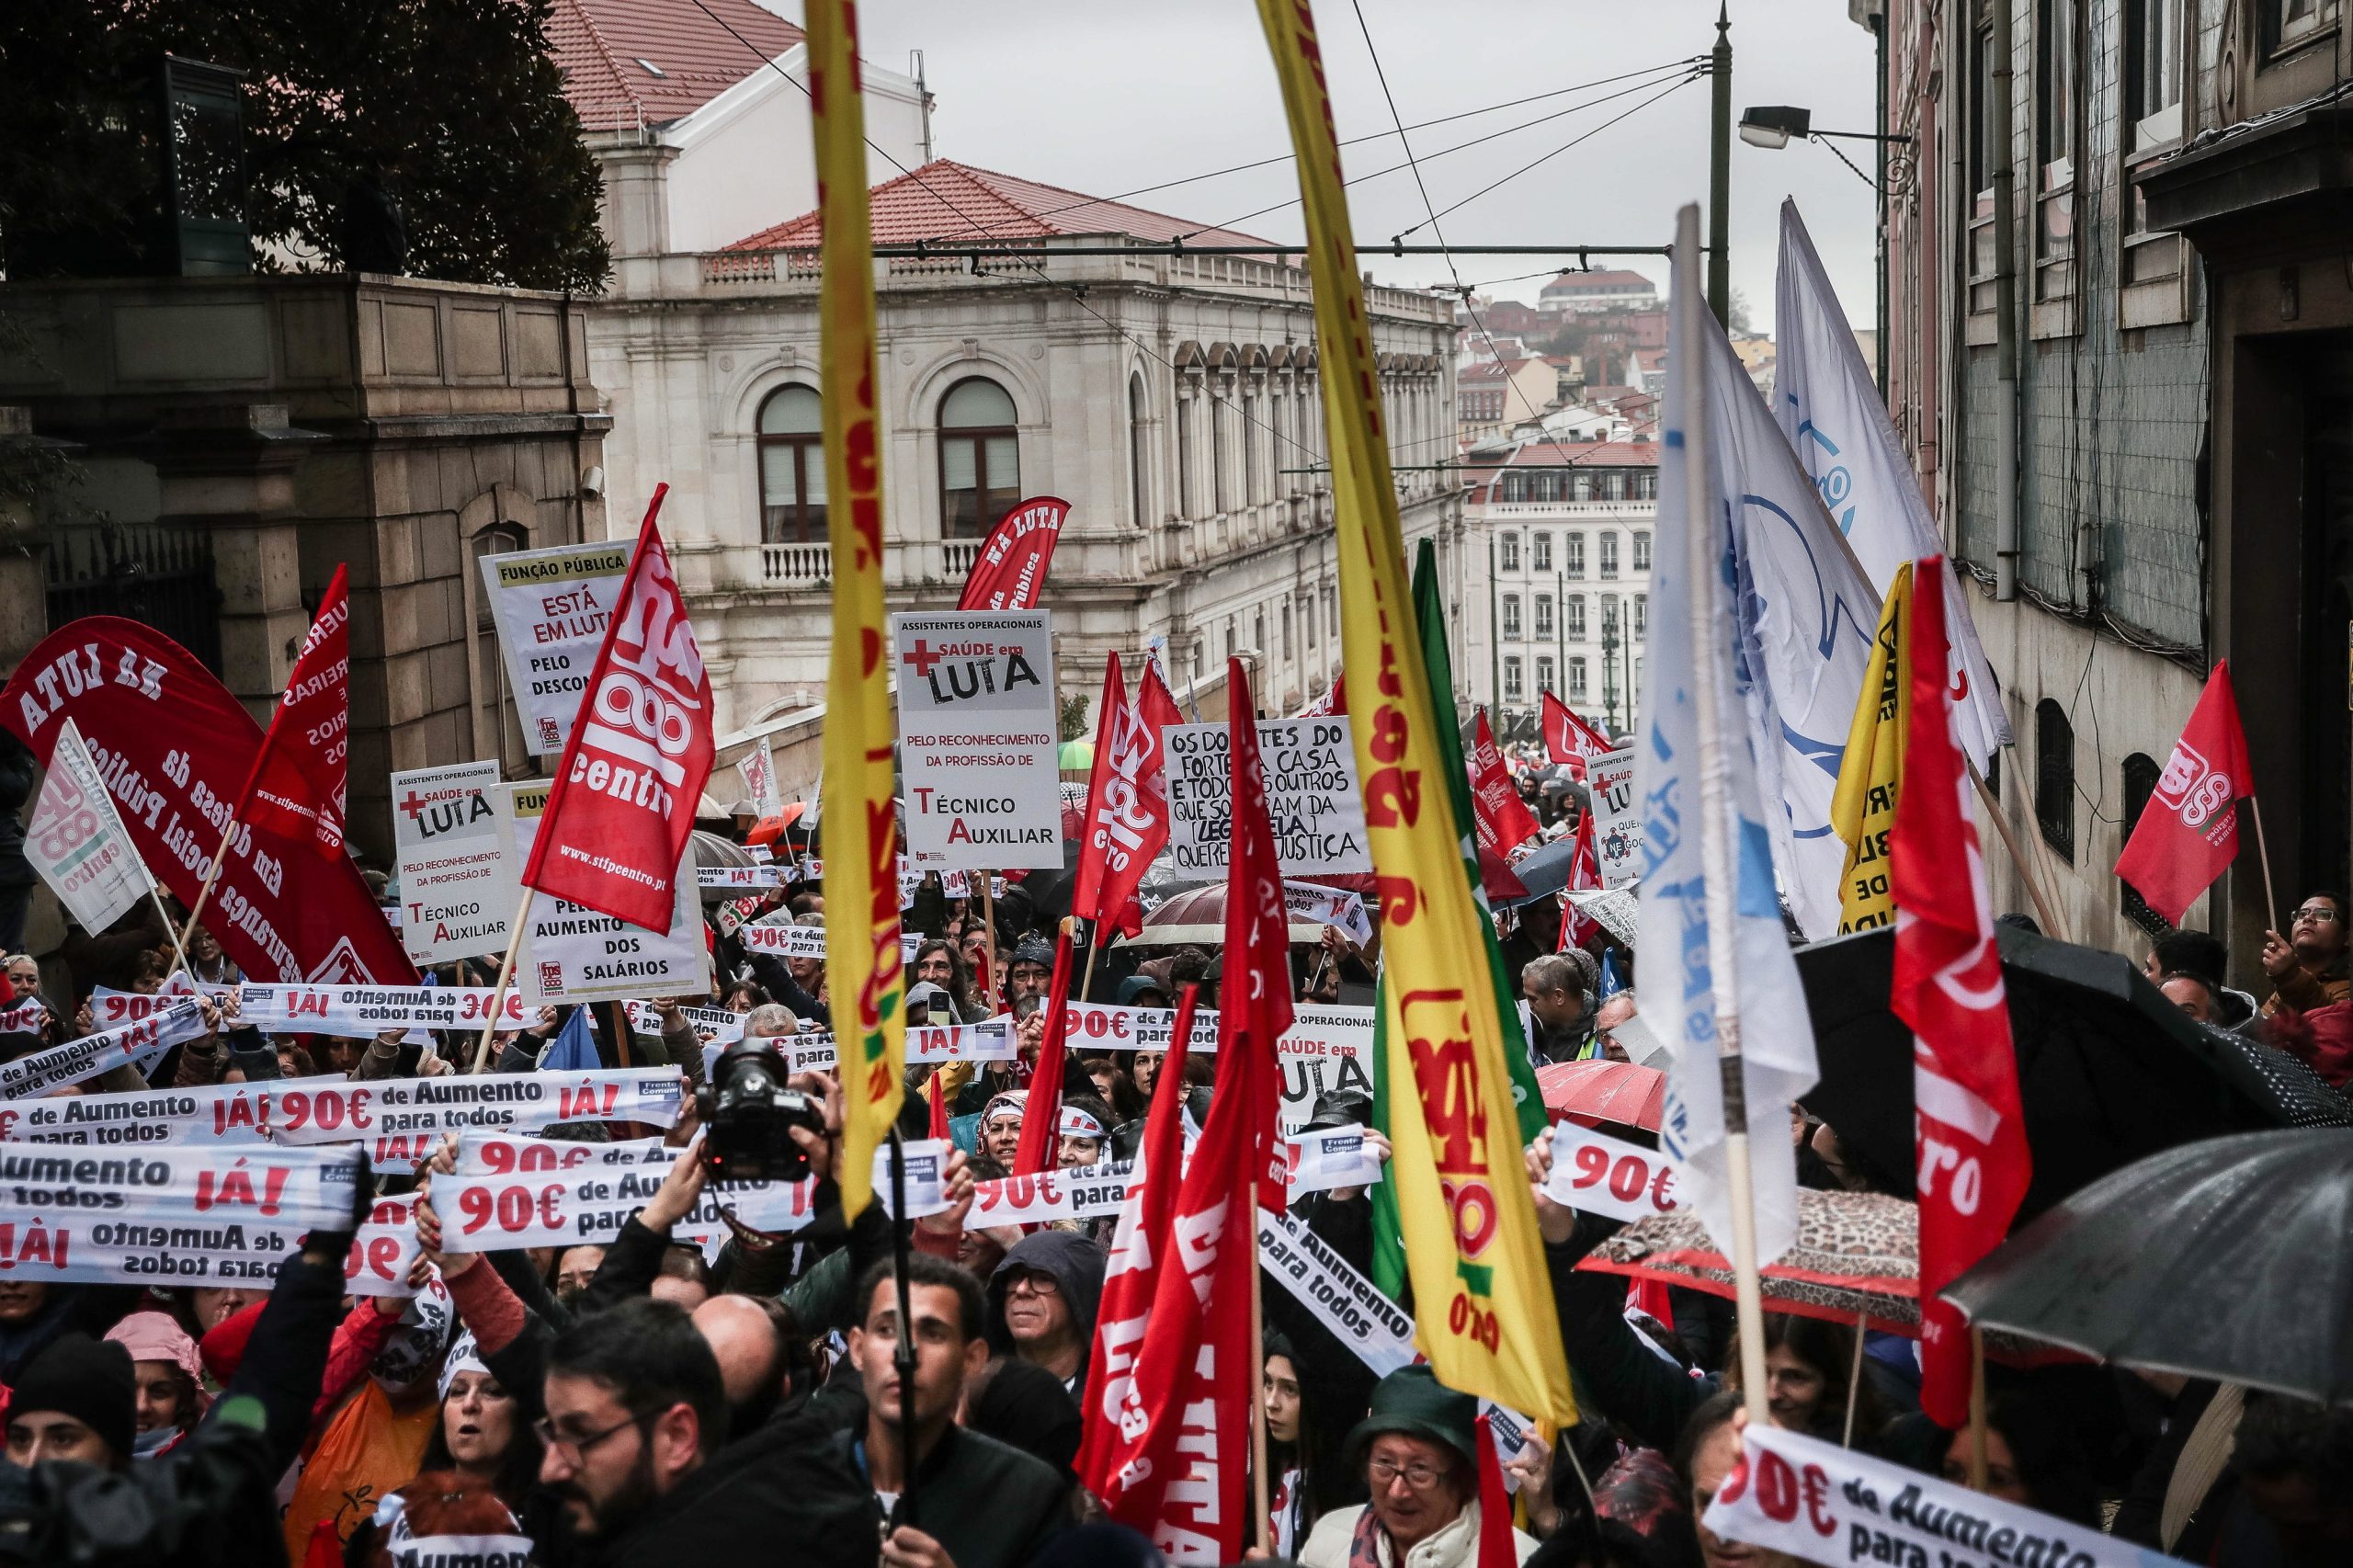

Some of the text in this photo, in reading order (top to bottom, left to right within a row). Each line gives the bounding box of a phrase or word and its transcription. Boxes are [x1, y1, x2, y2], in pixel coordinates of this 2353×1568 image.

[986, 506, 1059, 567] NA LUTA
[500, 555, 626, 582] FUNÇÃO PÚBLICA
[1009, 552, 1040, 610] Pública
[541, 585, 598, 617] ESTÁ
[533, 620, 568, 643] EM
[902, 619, 1042, 631] ASSISTENTES OPERACIONAIS
[938, 642, 1023, 656] SAÚDE em
[530, 656, 570, 673] PELO
[927, 653, 1040, 705] LUTA
[907, 734, 1050, 746] PELO RECONHECIMENTO
[1172, 733, 1198, 754] OS
[1313, 725, 1343, 746] DO
[926, 751, 1033, 767] DA PROFISSÃO DE
[1277, 748, 1341, 774] CASA
[1590, 757, 1621, 769] ASSISTENTES
[397, 767, 494, 786] ASSISTENTES OPERACIONAIS
[568, 752, 675, 822] centro
[1172, 779, 1183, 800] E
[1275, 771, 1348, 792] OUTROS
[424, 788, 482, 802] SAÚDE em
[913, 788, 1016, 815] TÉCNICO
[418, 794, 494, 839] LUTA
[1174, 795, 1337, 822] QUE DA
[947, 818, 1054, 845] AUXILIAR
[403, 851, 501, 873] PELO RECONHECIMENTO
[561, 844, 666, 892] www.stfpcentro.pt
[916, 851, 927, 862] fps
[417, 869, 491, 887] DA PROFISSÃO DE
[731, 869, 754, 883] JÁ!
[408, 902, 480, 924] TÉCNICO
[433, 921, 506, 944] AUXILIAR
[536, 917, 624, 937] AUMENTO
[791, 931, 802, 939] de
[605, 938, 641, 955] DOS
[790, 941, 814, 952] para
[583, 960, 669, 980] SALÁRIOS
[1136, 1012, 1157, 1025] de
[793, 1035, 813, 1046] de
[1279, 1037, 1357, 1057] AÚDE em
[3, 1068, 23, 1084] de
[25, 1035, 111, 1077] Aumento
[795, 1048, 835, 1068] para
[5, 1059, 96, 1101] para todos
[1279, 1055, 1373, 1103] UTA
[29, 1090, 270, 1137] de Aumento JÁ!
[282, 1076, 621, 1131] 90€ de Aumento JÁ!
[381, 1106, 514, 1133] para todos
[96, 1122, 168, 1145] todos
[0, 1156, 292, 1215] umento JÁ!
[1573, 1145, 1677, 1212] 90€
[13, 1186, 124, 1209] todos
[459, 1181, 609, 1235] 90€ de
[1072, 1185, 1125, 1211] para
[1300, 1233, 1409, 1338] Aumento
[1308, 1274, 1373, 1338] todos
[1843, 1478, 1881, 1514] de
